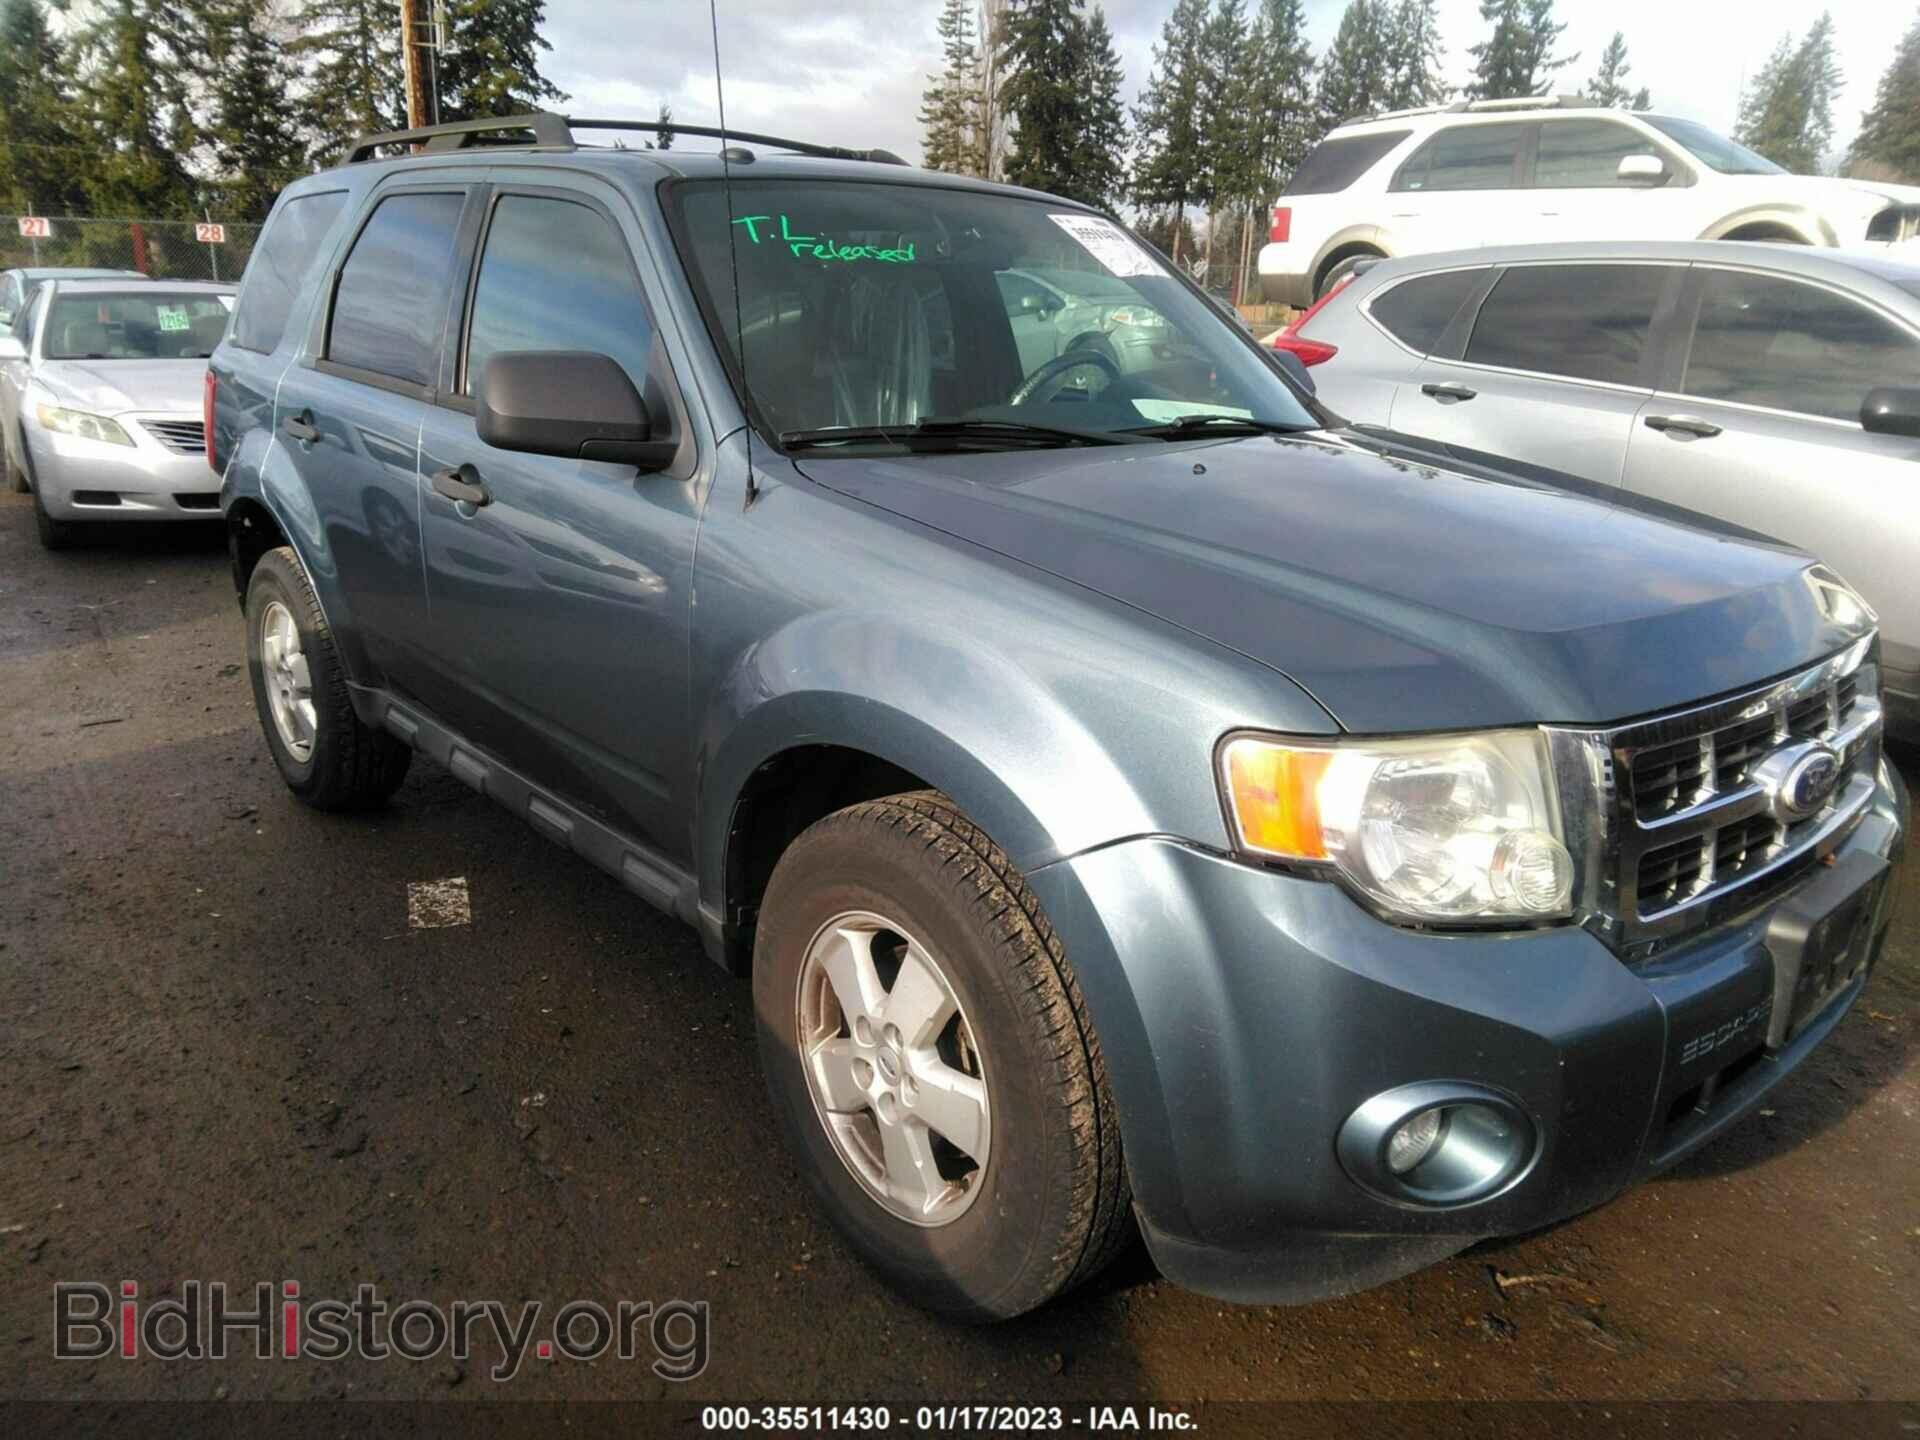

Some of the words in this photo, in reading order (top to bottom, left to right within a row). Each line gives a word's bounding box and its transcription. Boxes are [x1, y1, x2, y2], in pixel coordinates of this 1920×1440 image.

[24, 219, 46, 236] 27
[199, 225, 221, 241] 28
[791, 239, 915, 262] released
